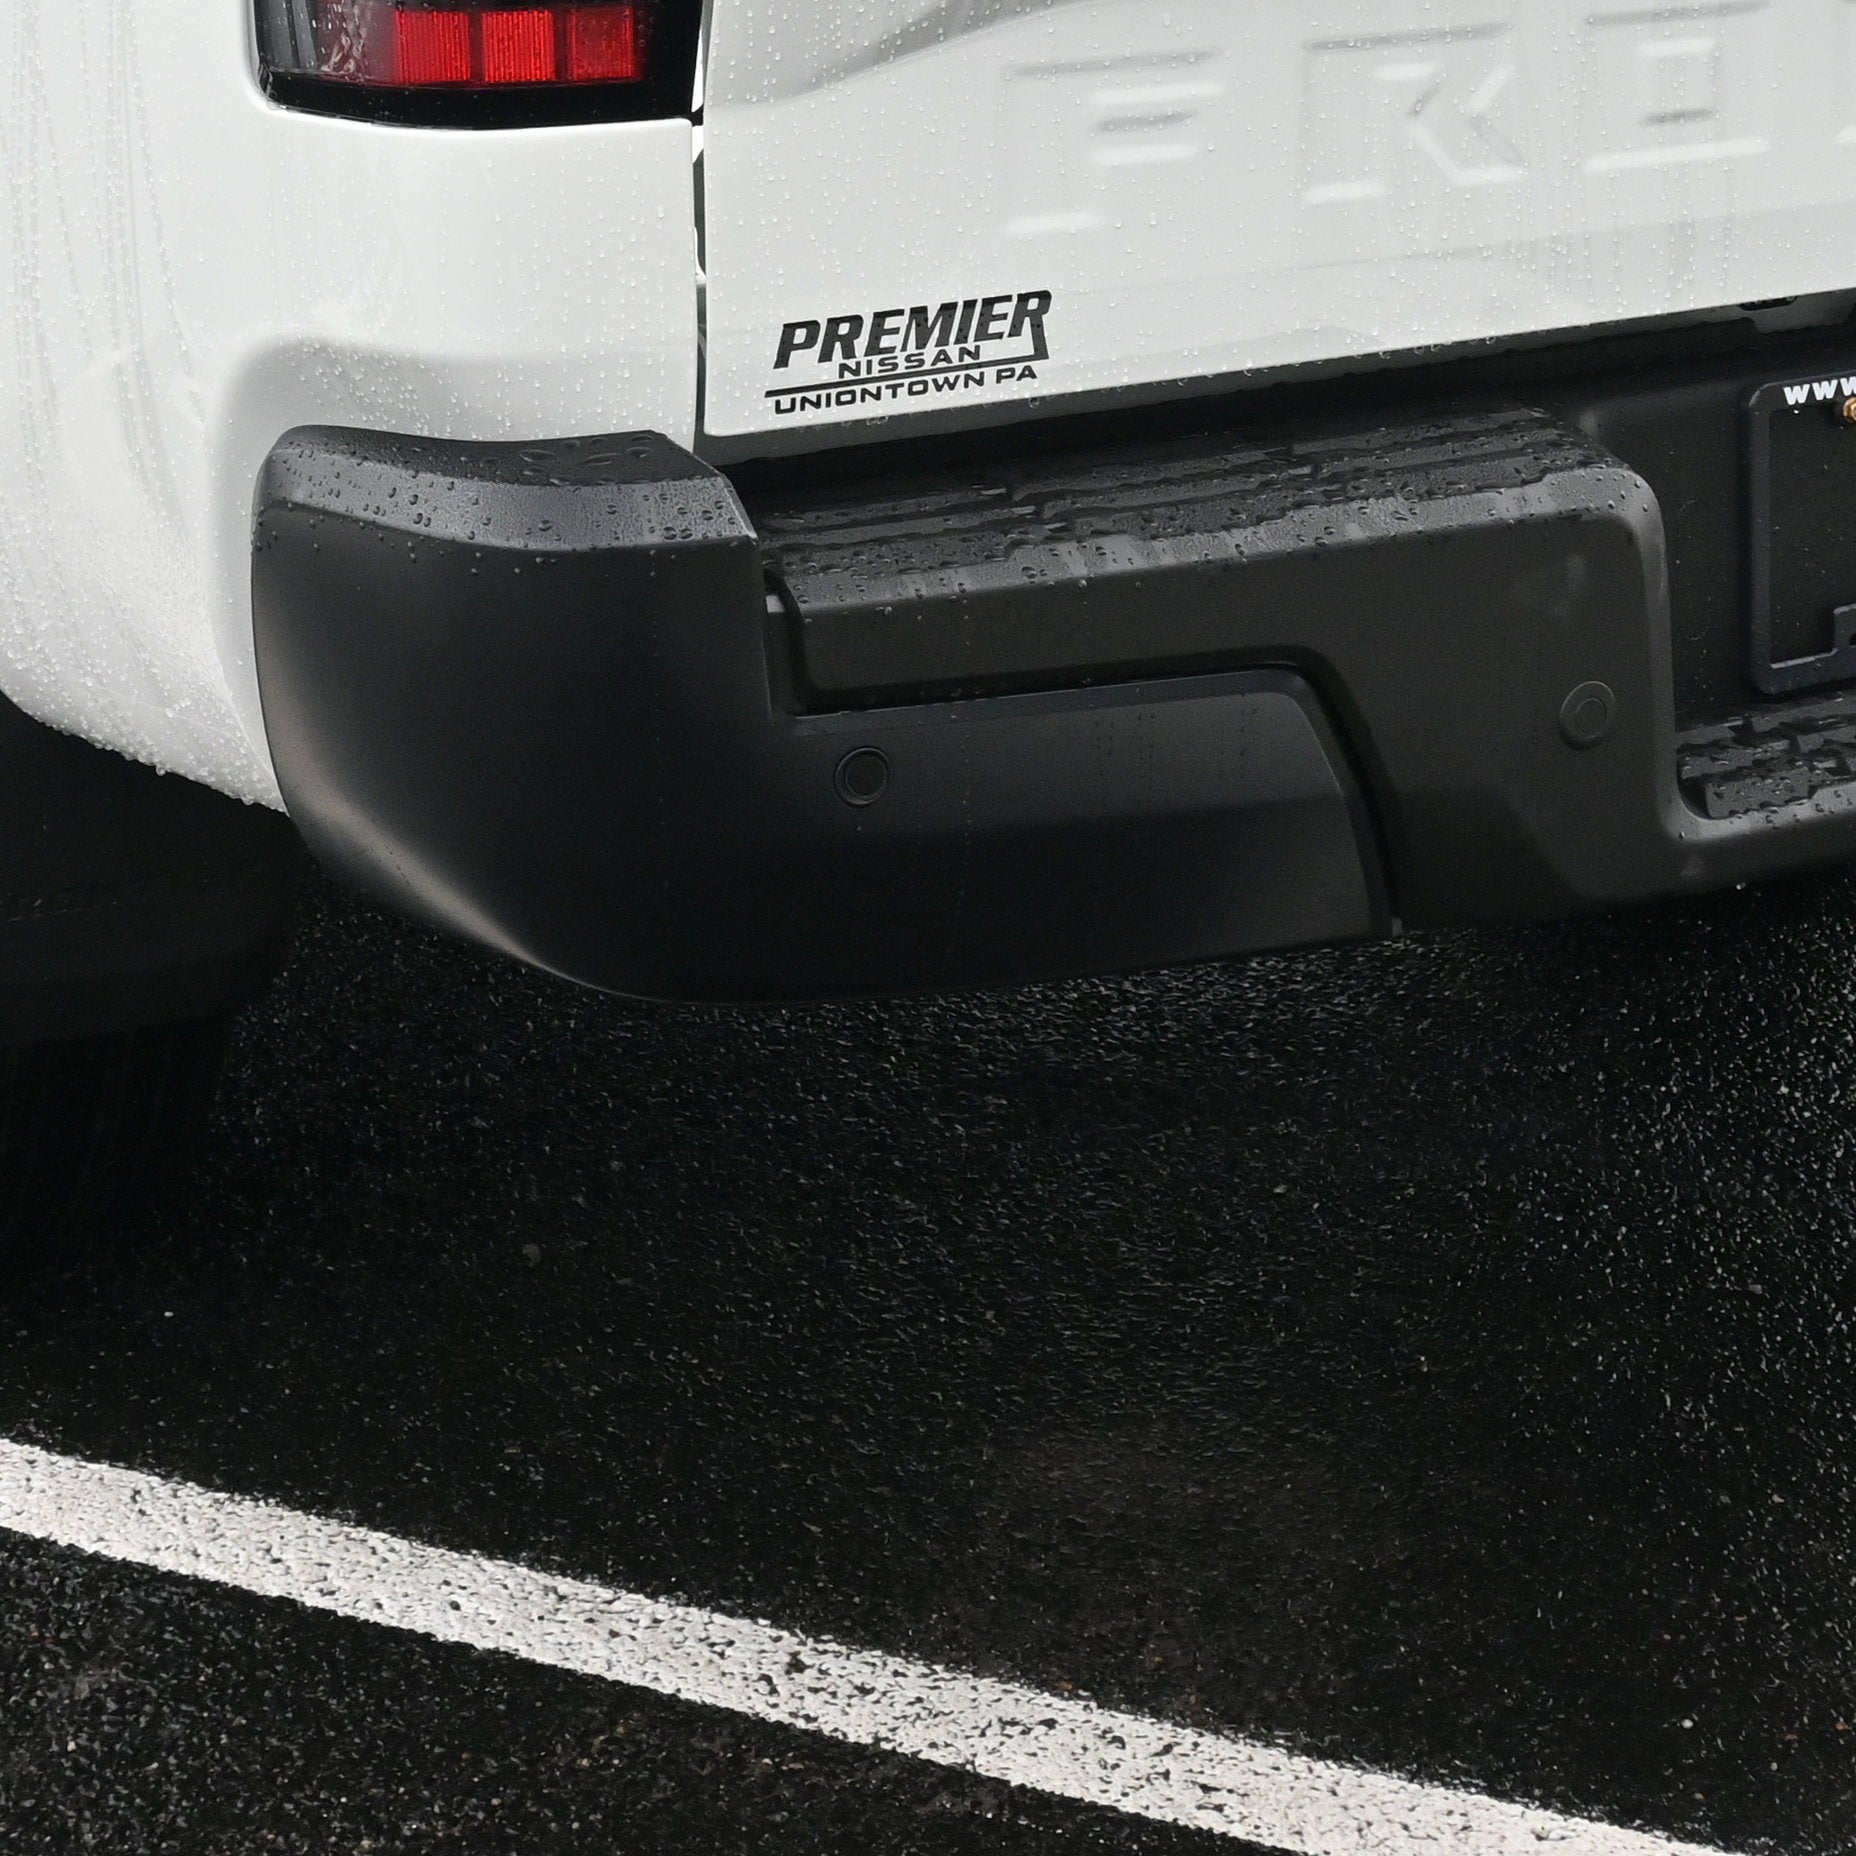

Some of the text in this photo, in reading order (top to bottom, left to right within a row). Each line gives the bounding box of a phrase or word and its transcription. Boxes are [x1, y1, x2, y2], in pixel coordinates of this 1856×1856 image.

[772, 289, 1053, 369] PREMIER
[837, 344, 982, 379] NISSAN
[774, 364, 1038, 415] UNIONTOWN PA
